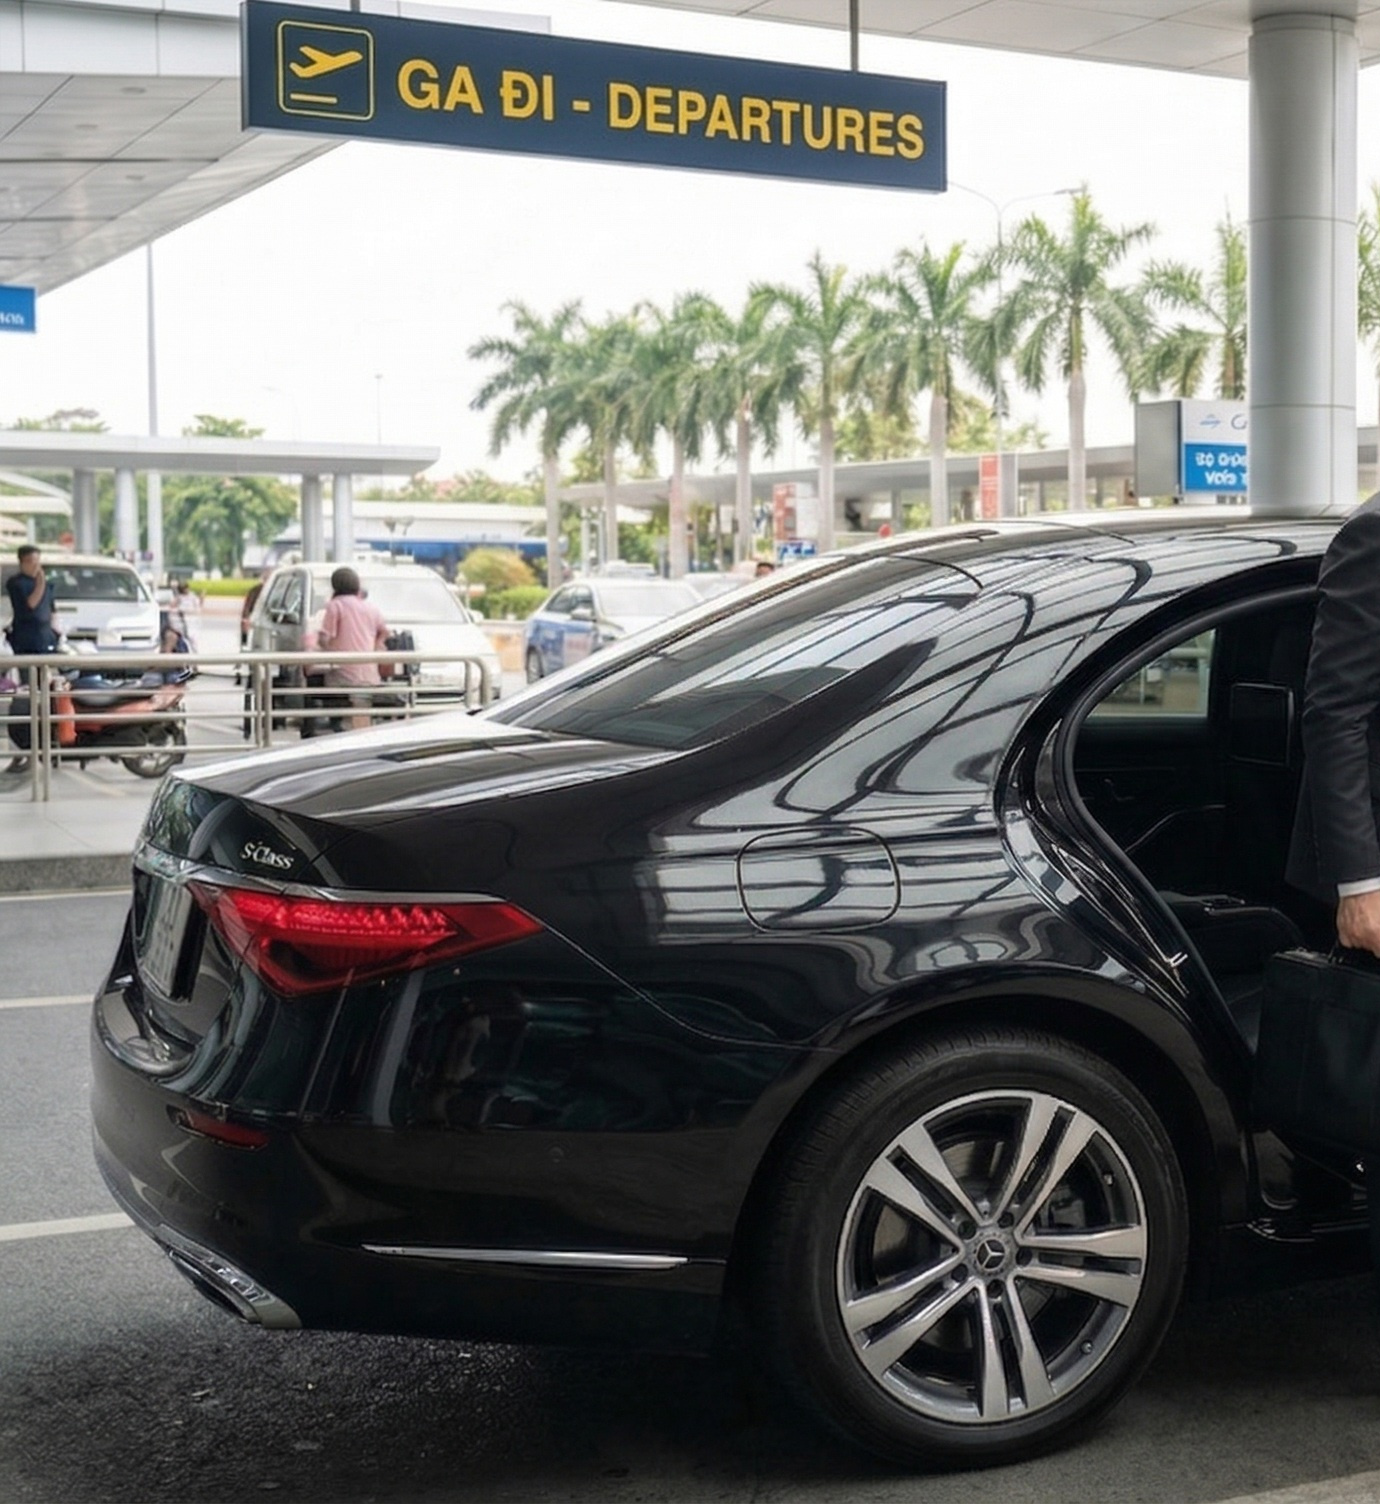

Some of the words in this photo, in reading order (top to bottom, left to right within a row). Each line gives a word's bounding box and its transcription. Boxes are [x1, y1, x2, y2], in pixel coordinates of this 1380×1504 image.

[397, 59, 484, 113] GA
[499, 70, 555, 119] ĐI
[609, 83, 925, 159] DEPARTURES
